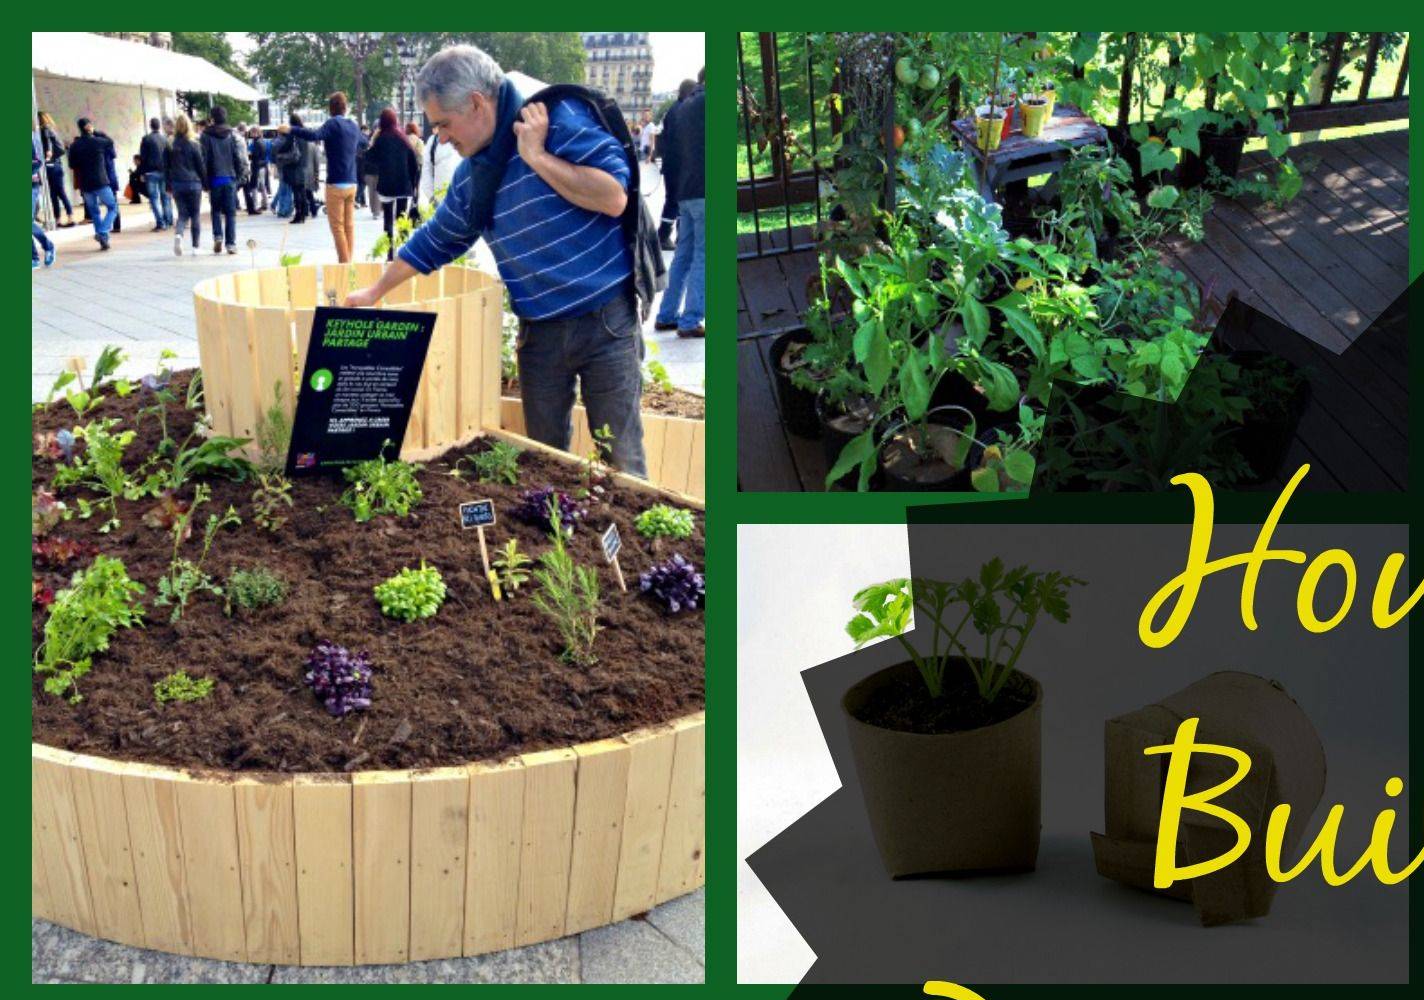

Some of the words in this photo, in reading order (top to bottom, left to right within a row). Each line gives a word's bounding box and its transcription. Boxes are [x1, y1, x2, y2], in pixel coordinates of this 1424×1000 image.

[326, 319, 374, 330] KEYHOLE
[376, 320, 419, 332] GARDEN
[324, 329, 365, 339] JARDIN
[367, 330, 408, 339] URBAIN
